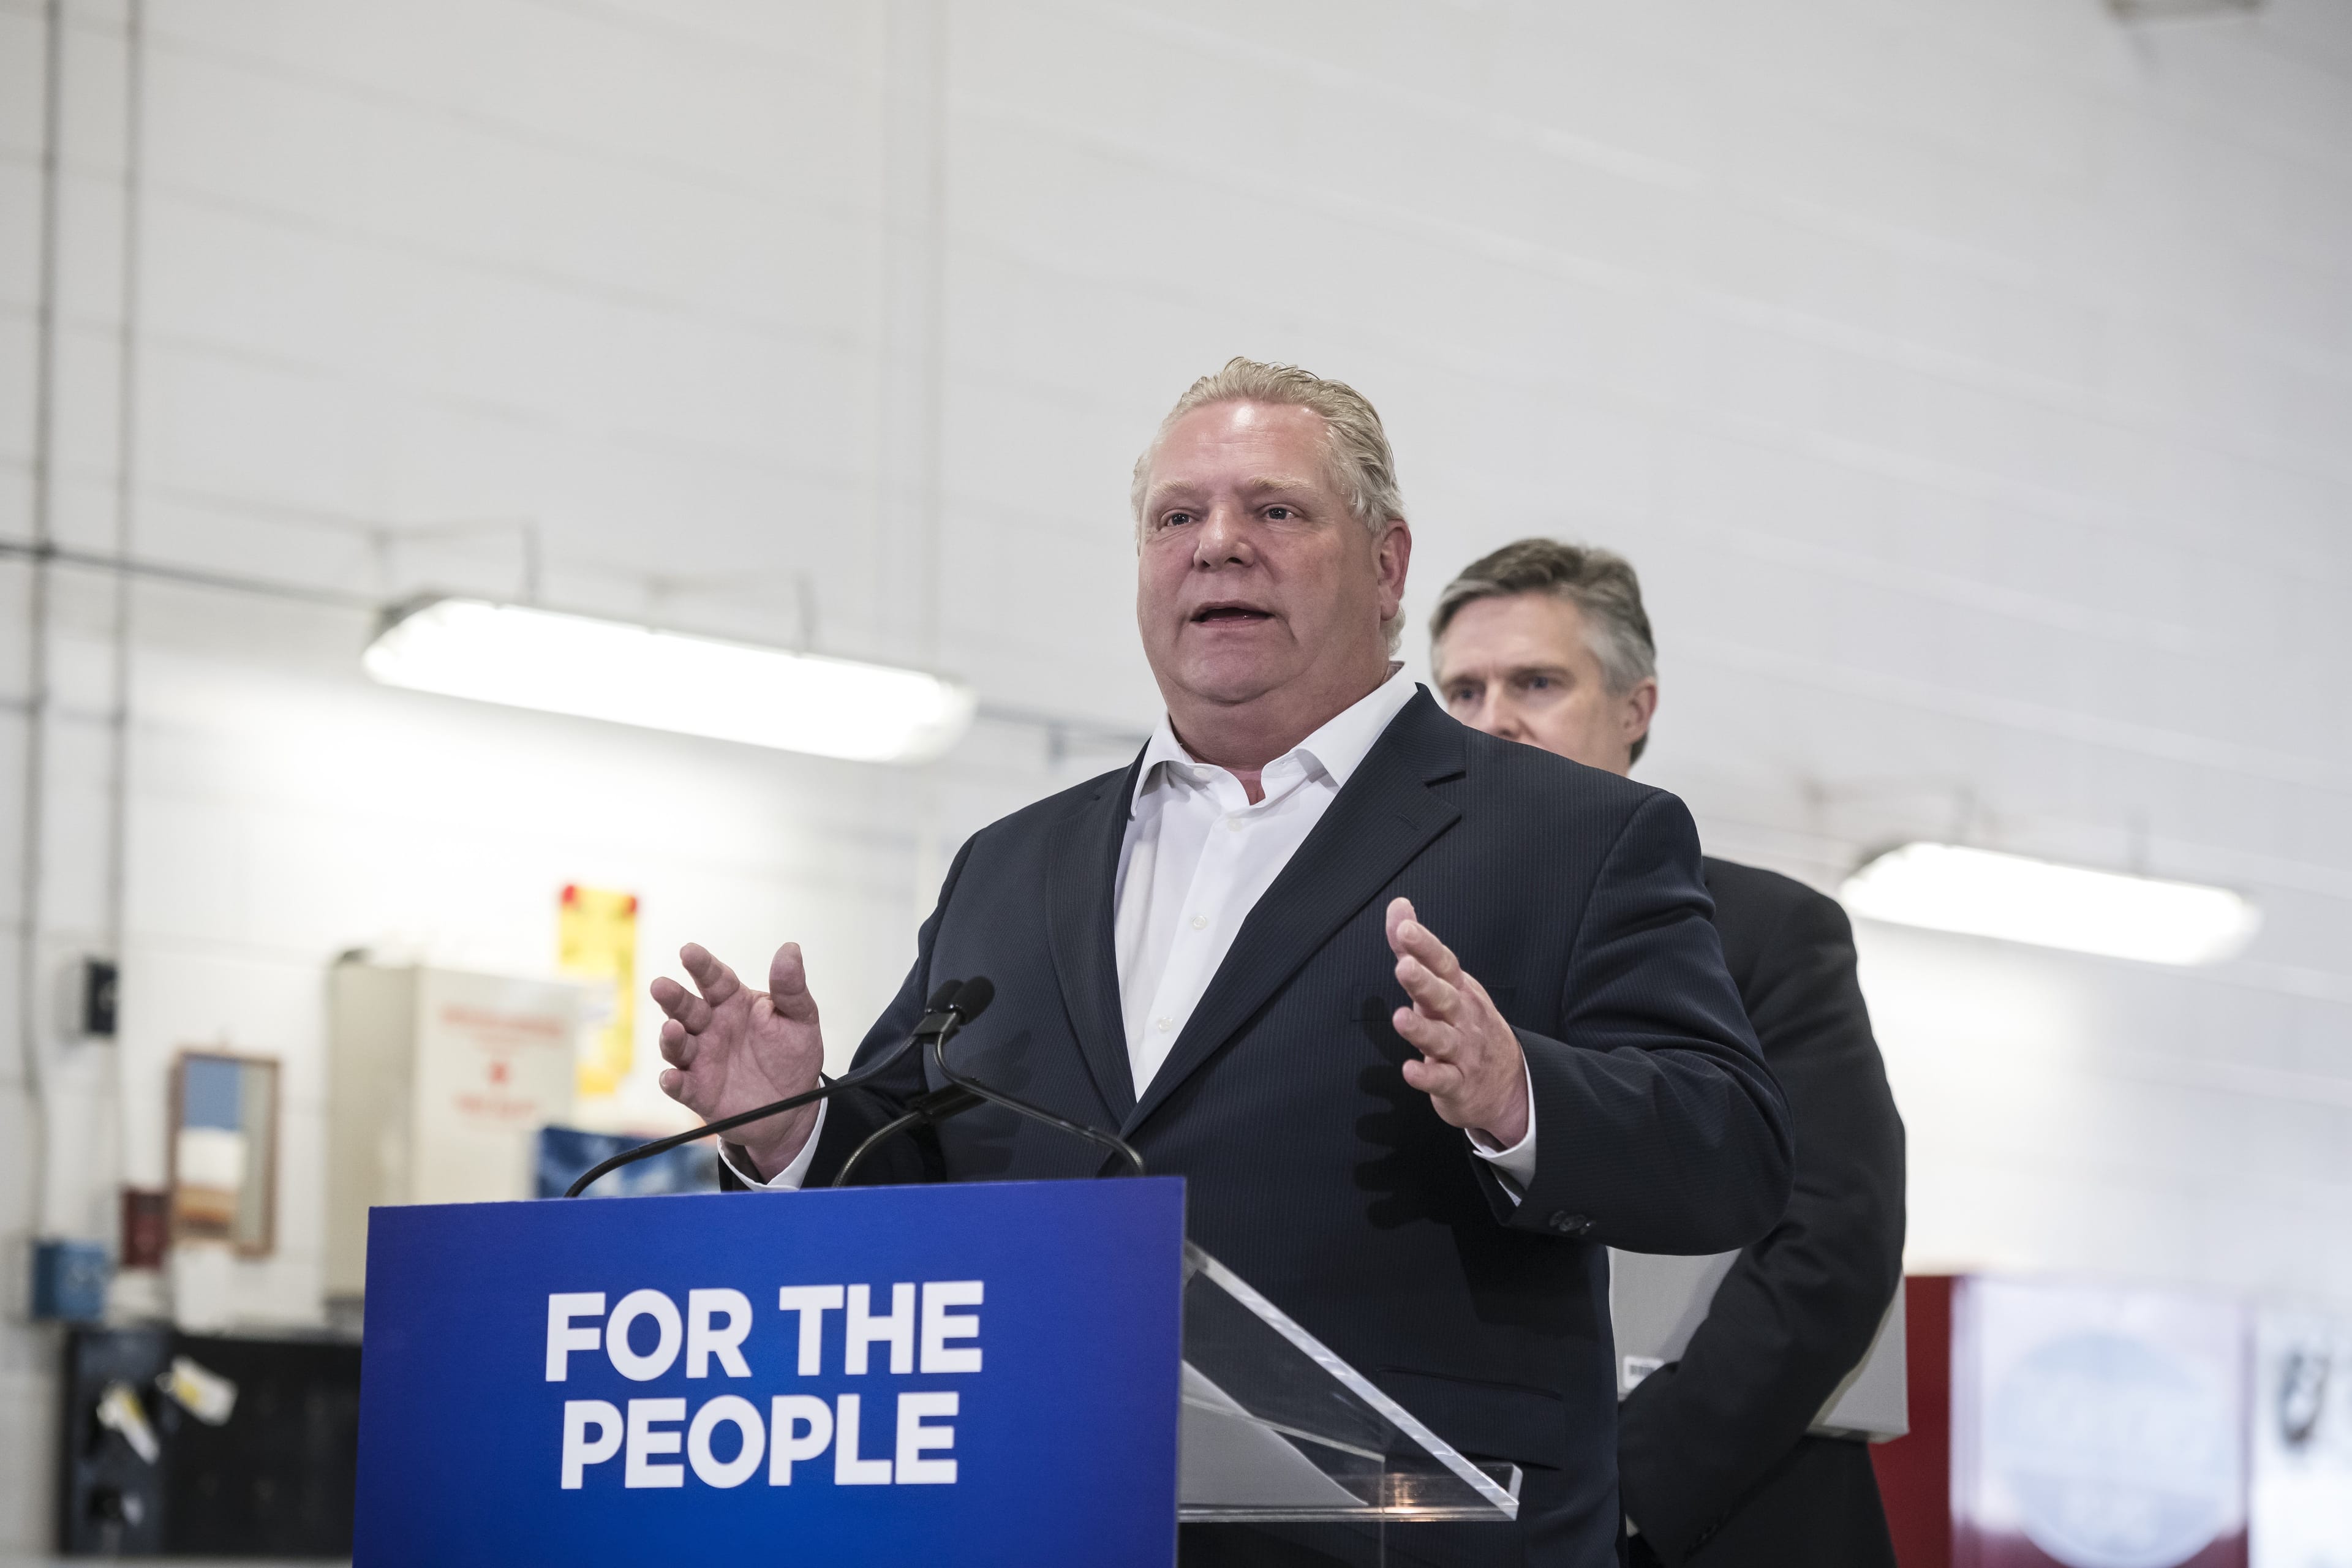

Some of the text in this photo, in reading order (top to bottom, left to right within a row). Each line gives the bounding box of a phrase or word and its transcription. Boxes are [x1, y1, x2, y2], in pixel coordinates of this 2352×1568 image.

[545, 1280, 984, 1382] FOR THE
[561, 1391, 959, 1490] PEOPLE
